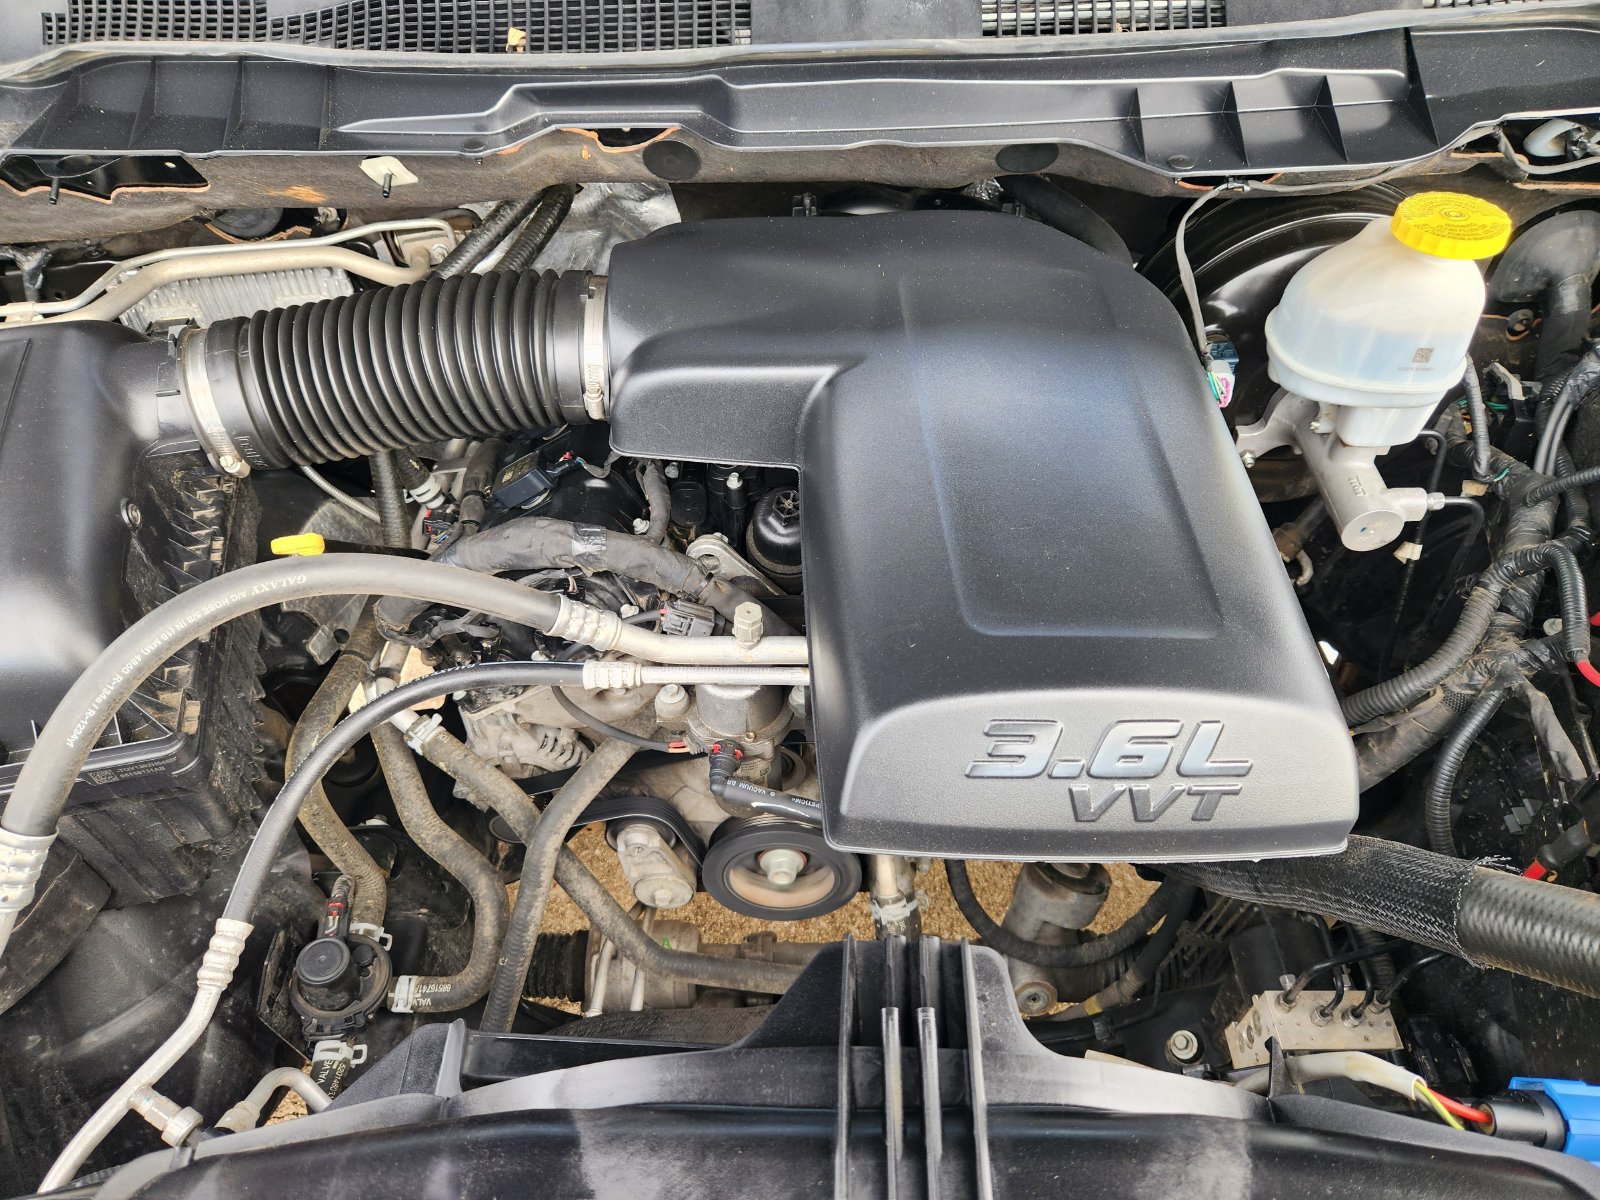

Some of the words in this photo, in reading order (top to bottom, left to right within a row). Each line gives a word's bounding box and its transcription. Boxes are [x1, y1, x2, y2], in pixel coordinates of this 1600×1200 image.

[252, 575, 307, 595] GALAXY
[204, 599, 230, 612] HOSE
[66, 708, 96, 748] R-1234yf
[965, 719, 1253, 779] 3.6L
[739, 782, 766, 795] VACUUM
[1068, 783, 1243, 822] VVT
[412, 997, 432, 1007] VALV
[316, 1059, 333, 1085] VALVE
